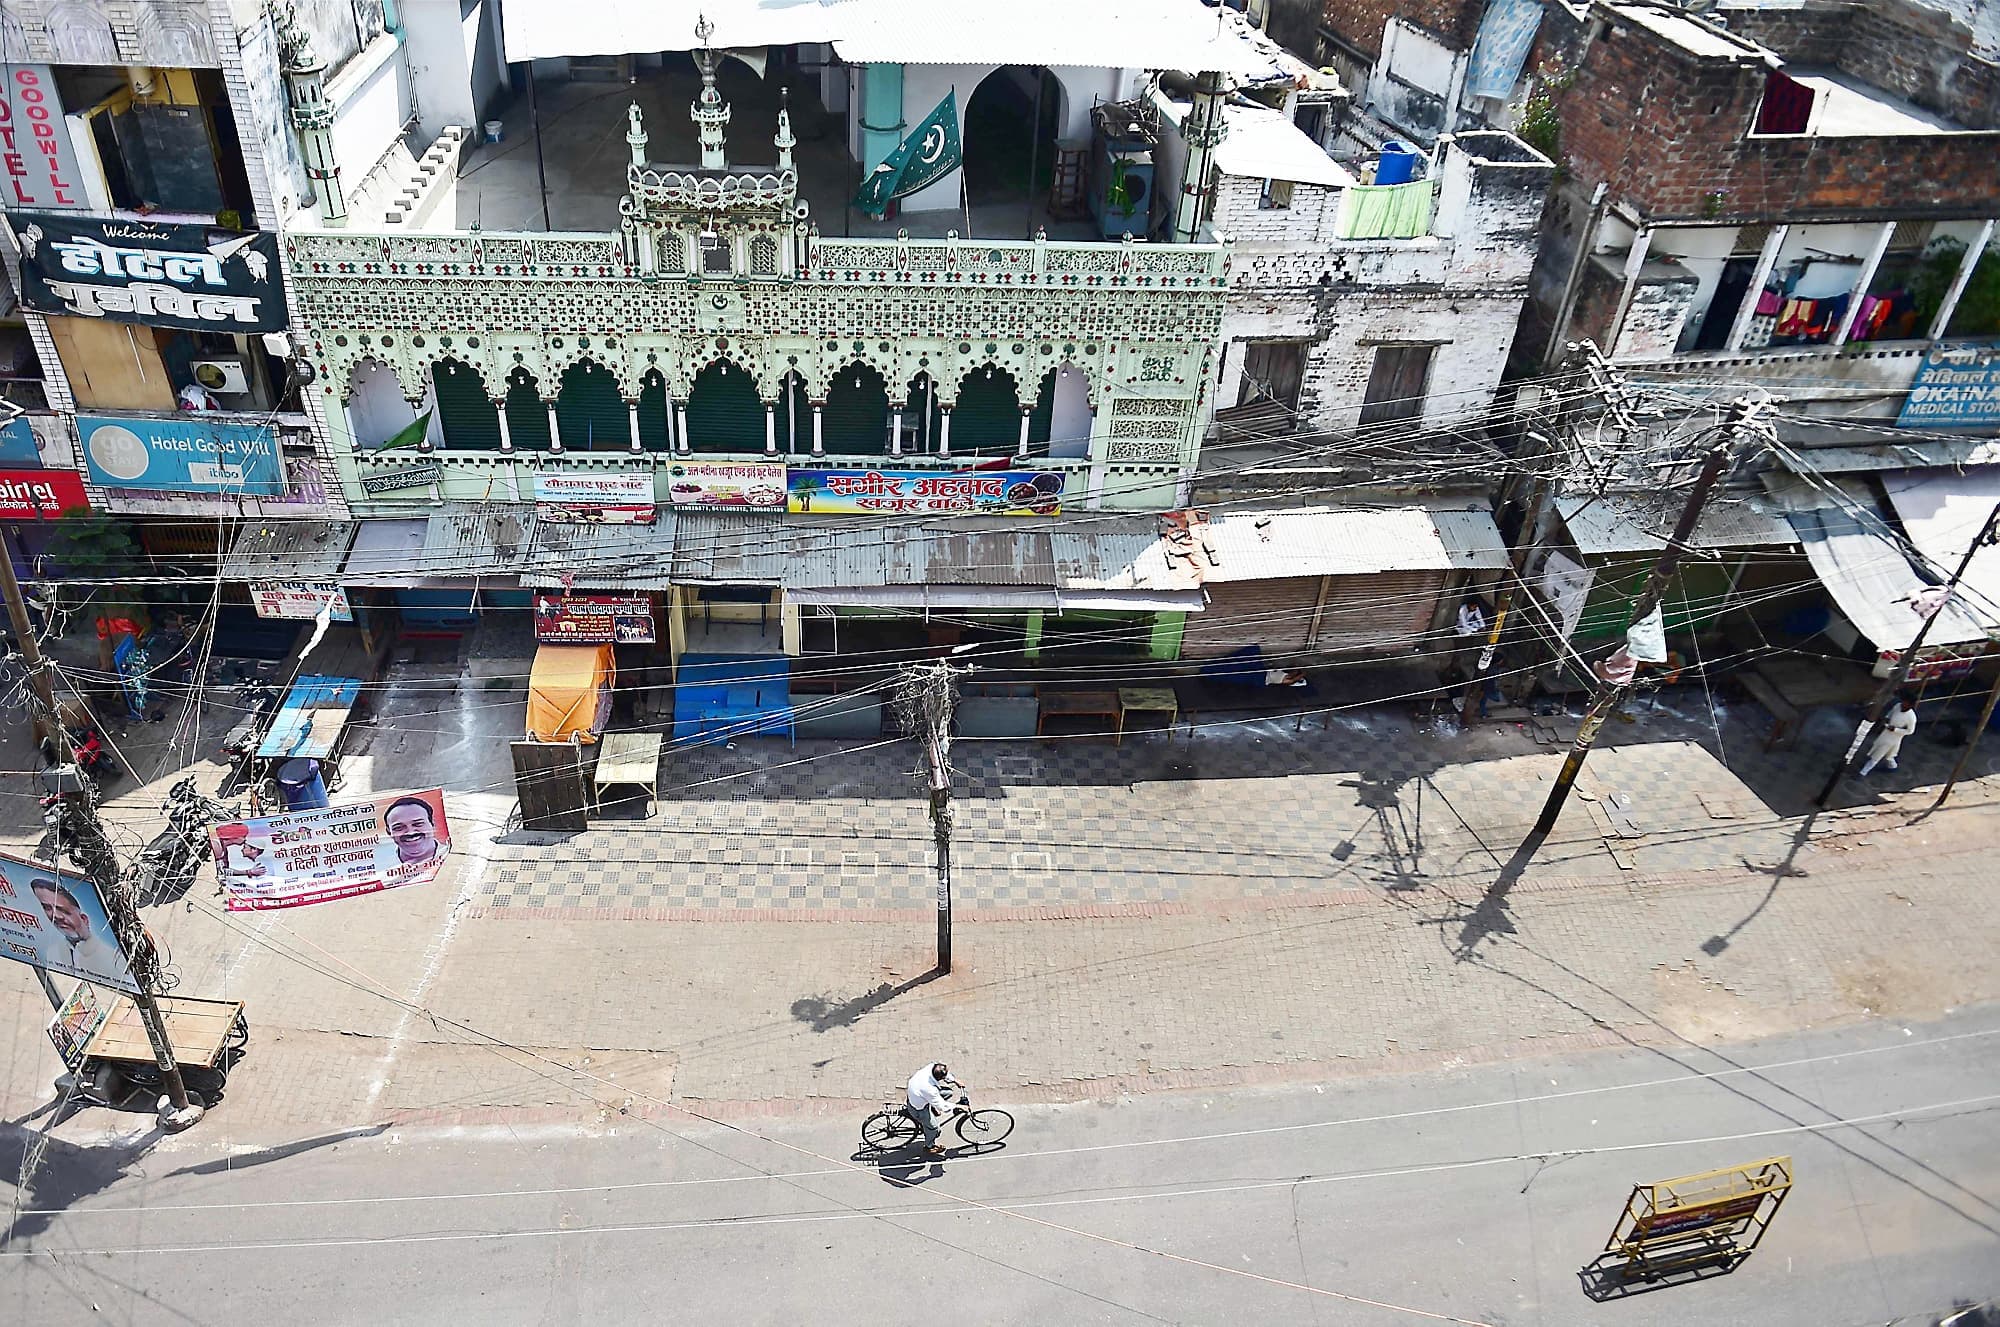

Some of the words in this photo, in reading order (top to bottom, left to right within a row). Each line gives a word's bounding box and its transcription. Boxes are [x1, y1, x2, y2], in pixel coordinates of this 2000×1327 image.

[15, 70, 75, 204] GOODWILL
[102, 223, 170, 241] Welcome
[50, 236, 228, 286] होटल
[43, 278, 263, 323] गुडविल
[1905, 403, 1963, 415] MEDICAL
[151, 435, 193, 452] Hotel
[195, 438, 236, 454] Good
[238, 440, 271, 456] Will
[826, 471, 908, 497] सगीर
[912, 476, 1007, 498] अहमद
[856, 497, 921, 512] खजूर
[268, 817, 291, 828] सभी
[360, 804, 375, 813] को
[270, 826, 313, 845] होली
[274, 847, 288, 859] की
[294, 856, 319, 871] दिली
